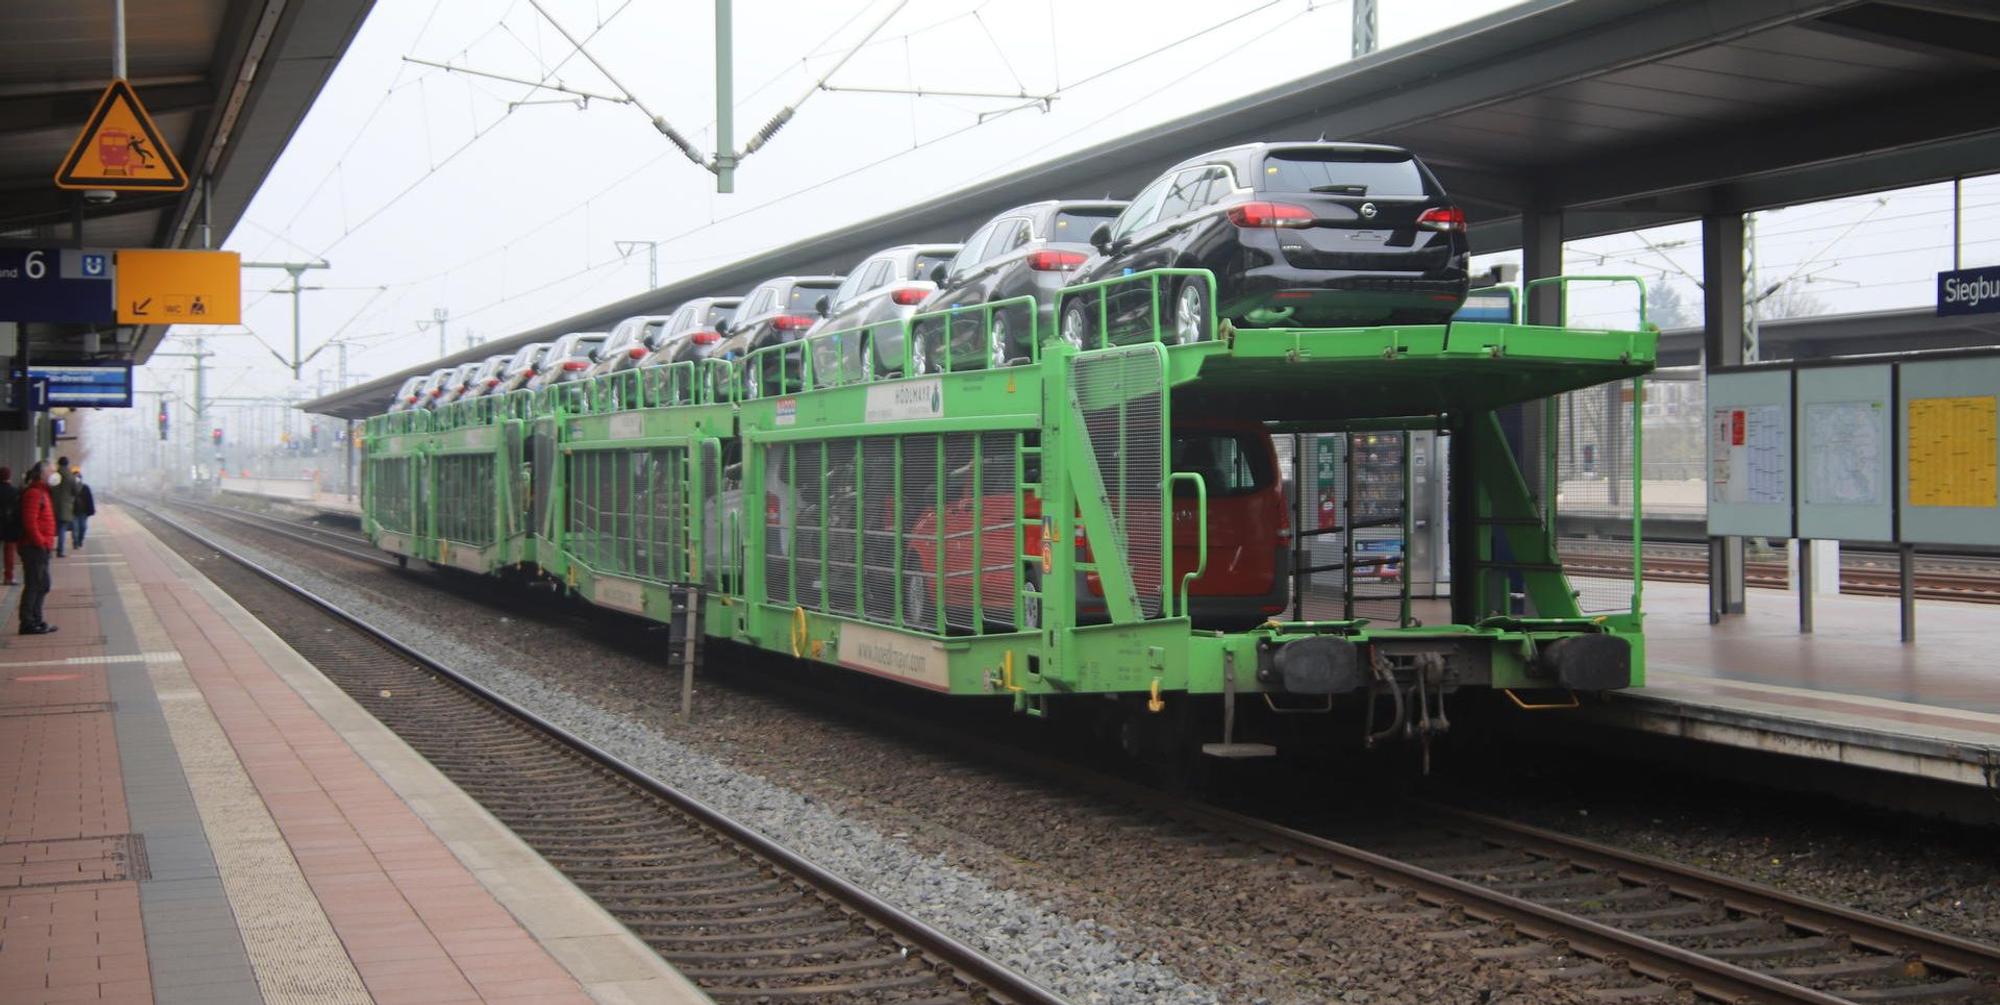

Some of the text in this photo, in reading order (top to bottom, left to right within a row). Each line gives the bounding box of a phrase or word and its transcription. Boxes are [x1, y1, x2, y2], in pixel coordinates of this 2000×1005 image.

[25, 250, 46, 279] 6
[1945, 275, 2000, 306] Siegbu
[33, 380, 46, 405] 1
